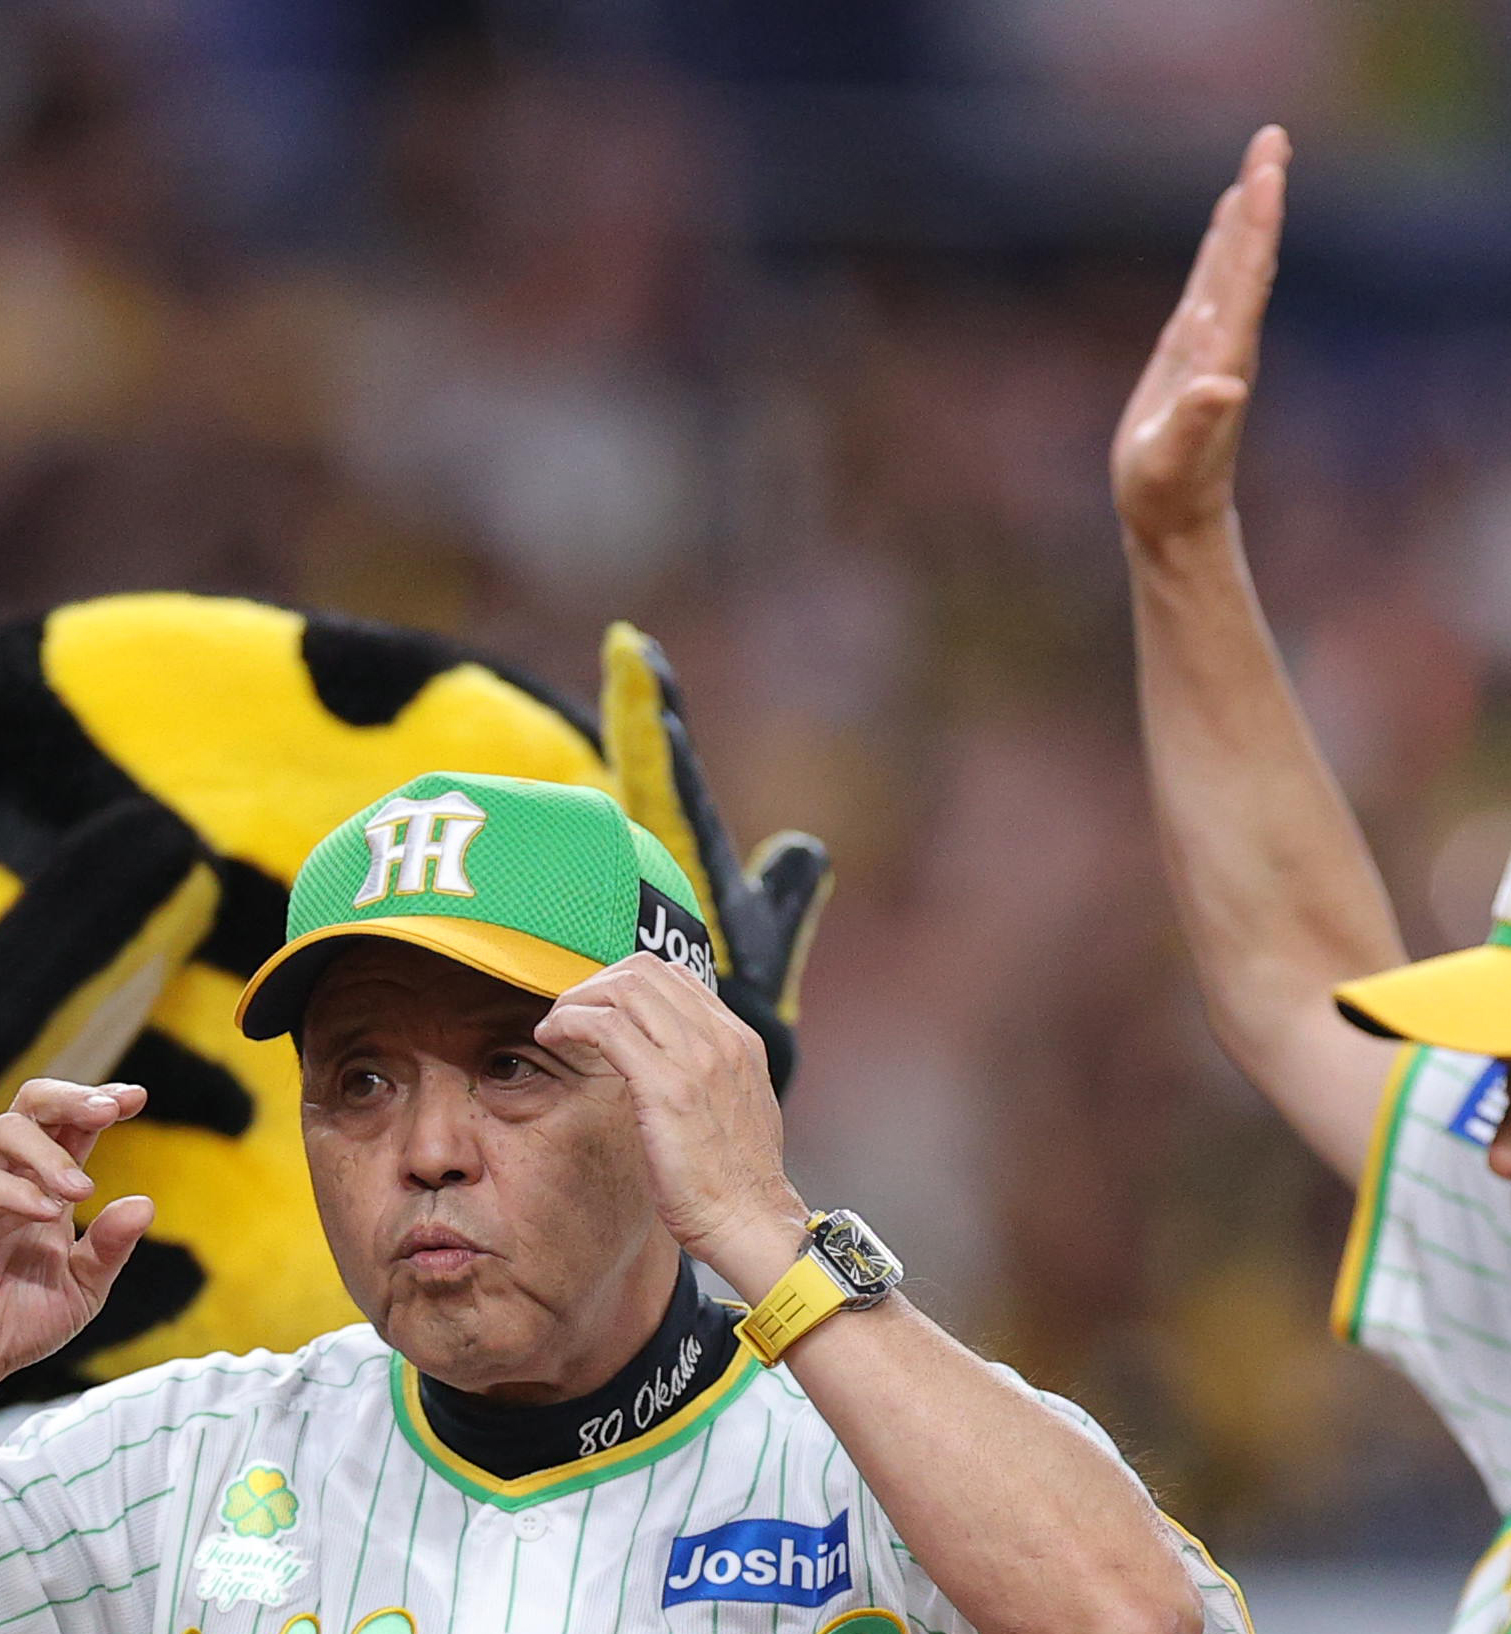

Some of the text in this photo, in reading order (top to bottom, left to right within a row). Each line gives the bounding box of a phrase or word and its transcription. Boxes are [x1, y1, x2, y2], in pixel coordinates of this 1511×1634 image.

[579, 1334, 702, 1456] 80 Okada
[196, 1538, 302, 1585] Family
[667, 1541, 849, 1593] Joshin
